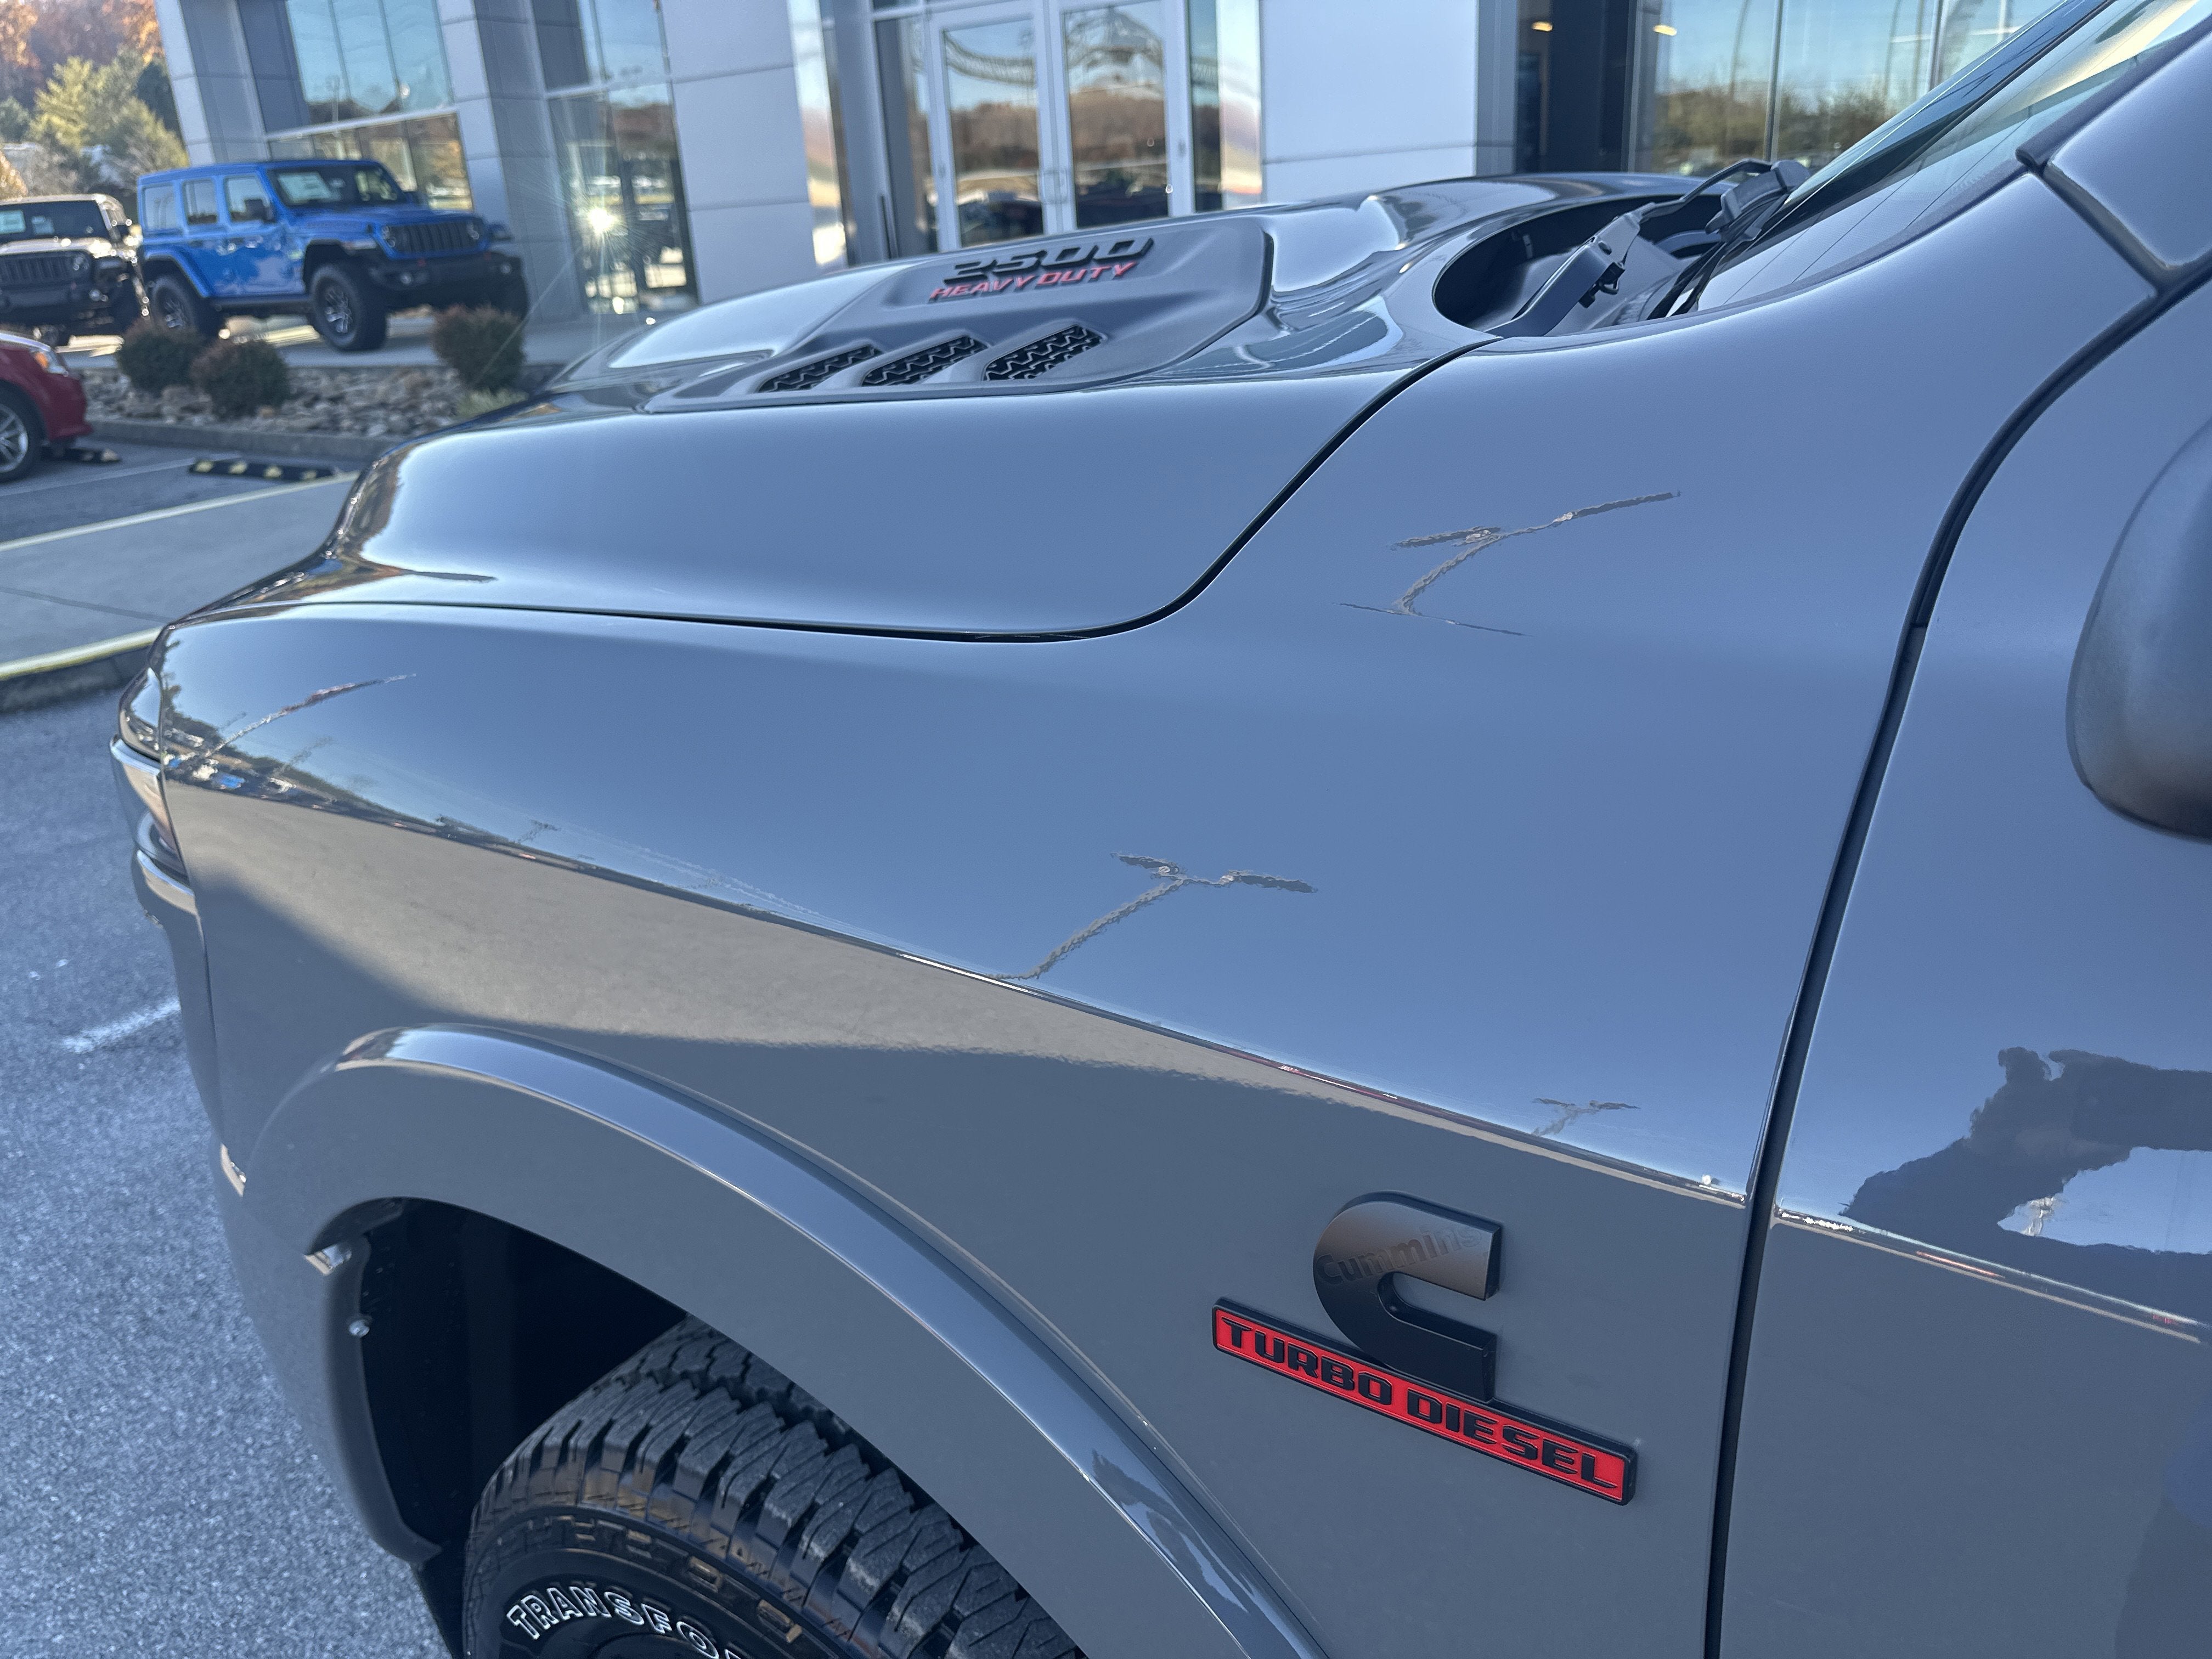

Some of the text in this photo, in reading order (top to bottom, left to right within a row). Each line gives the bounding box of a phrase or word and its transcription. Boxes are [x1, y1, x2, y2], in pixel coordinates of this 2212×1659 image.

[928, 261, 1138, 302] HEAVY DUTY
[941, 236, 1154, 285] 3500
[1317, 1224, 1482, 1285] Cummins
[1221, 1317, 1618, 1489] TURBO DIESEL
[506, 1586, 743, 1659] TRANSFO
